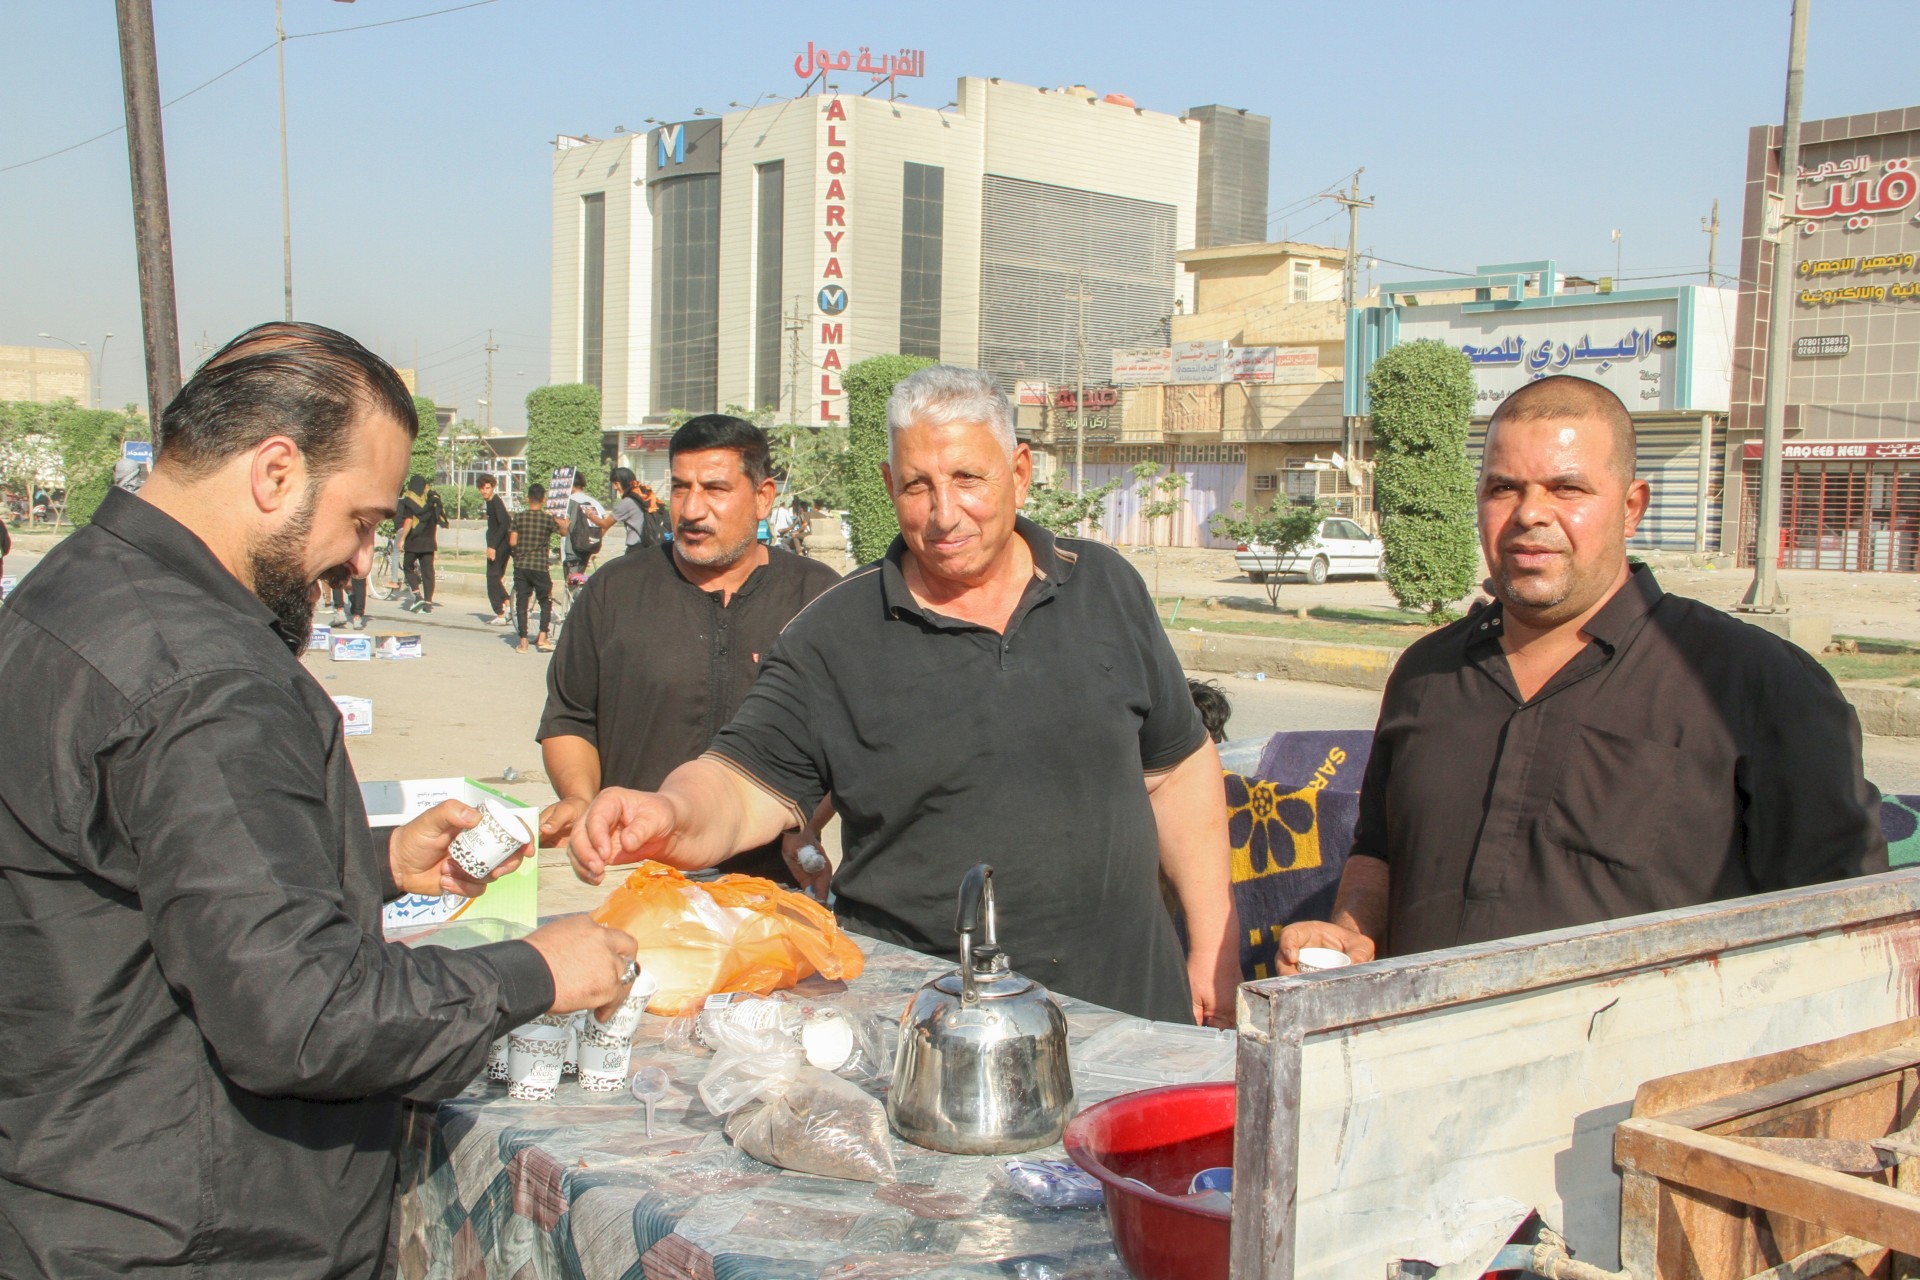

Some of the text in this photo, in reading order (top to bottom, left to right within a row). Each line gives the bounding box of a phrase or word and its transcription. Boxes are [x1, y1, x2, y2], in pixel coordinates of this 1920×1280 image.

[794, 41, 924, 84] القرية مول
[824, 99, 847, 280] ALQARYA
[1795, 158, 1920, 234] قيب
[1860, 254, 1914, 272] وتجهيز
[1460, 327, 1654, 380] البدري للصح
[1655, 333, 1676, 346] مجمع
[819, 323, 844, 422] MALL
[1055, 386, 1118, 411] صيدية
[1065, 416, 1088, 430] الواء
[1837, 445, 1868, 457] NEW
